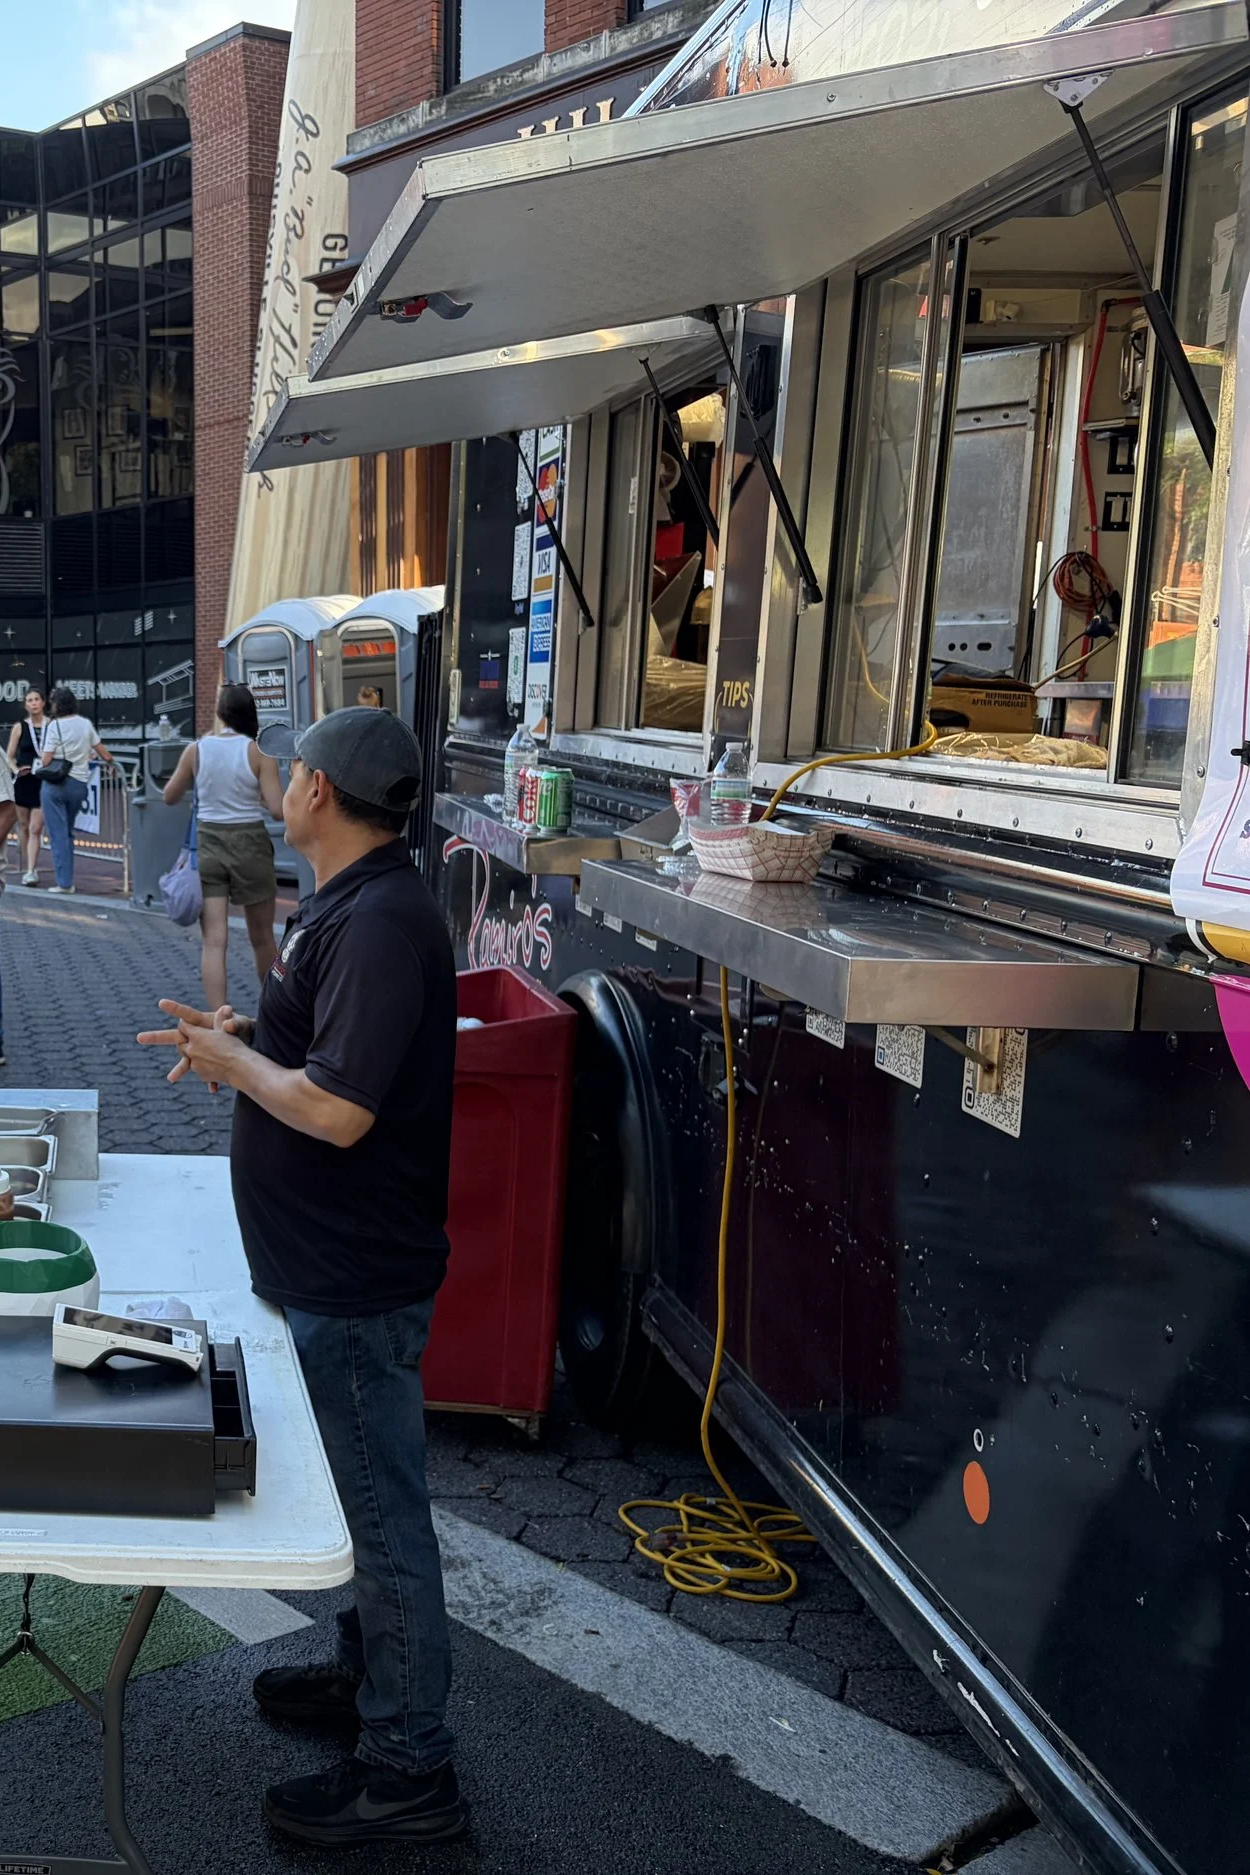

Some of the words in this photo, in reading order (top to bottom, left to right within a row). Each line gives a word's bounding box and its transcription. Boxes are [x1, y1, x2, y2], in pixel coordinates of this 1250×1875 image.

[536, 551, 551, 575] VISA
[722, 681, 750, 708] TIPS
[971, 698, 992, 706] AFTER
[993, 700, 1028, 708] PURCHASE
[985, 692, 1028, 700] REFRIGERATE
